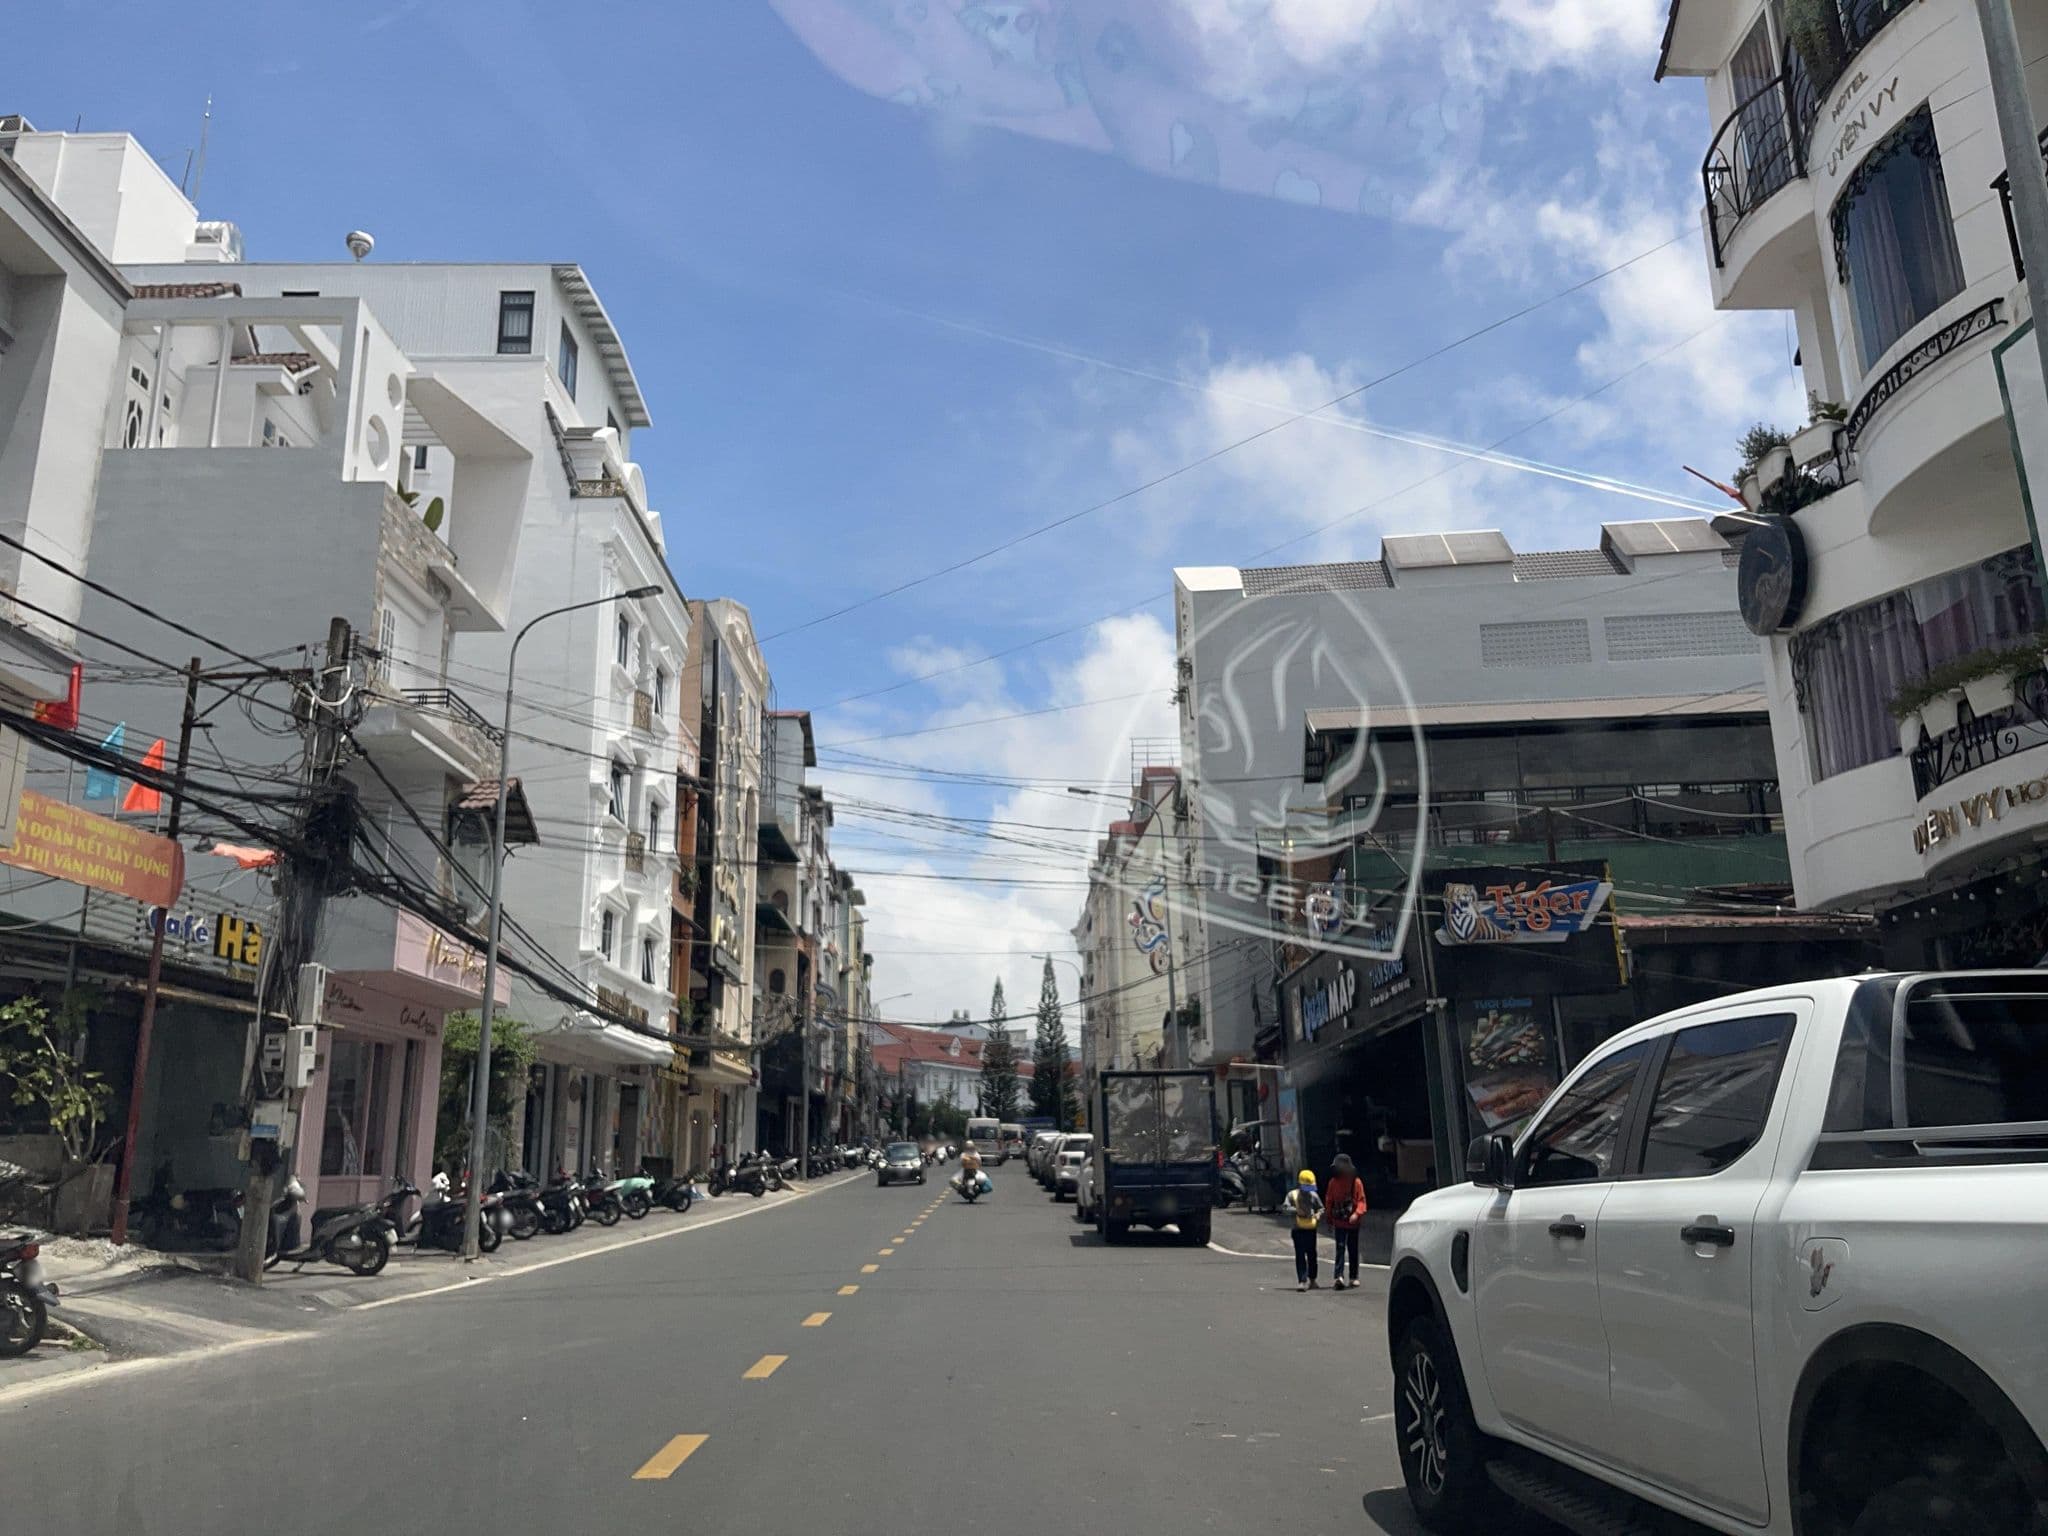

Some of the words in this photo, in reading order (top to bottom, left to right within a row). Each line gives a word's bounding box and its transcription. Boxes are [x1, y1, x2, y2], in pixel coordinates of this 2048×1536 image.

[1832, 72, 1868, 123] HOTEL
[1868, 77, 1898, 117] VY
[1960, 786, 2001, 828] VY
[2005, 777, 2048, 808] HO
[86, 863, 125, 887] MINH
[1485, 880, 1589, 932] Tiger
[1328, 959, 1355, 1029] MẬP
